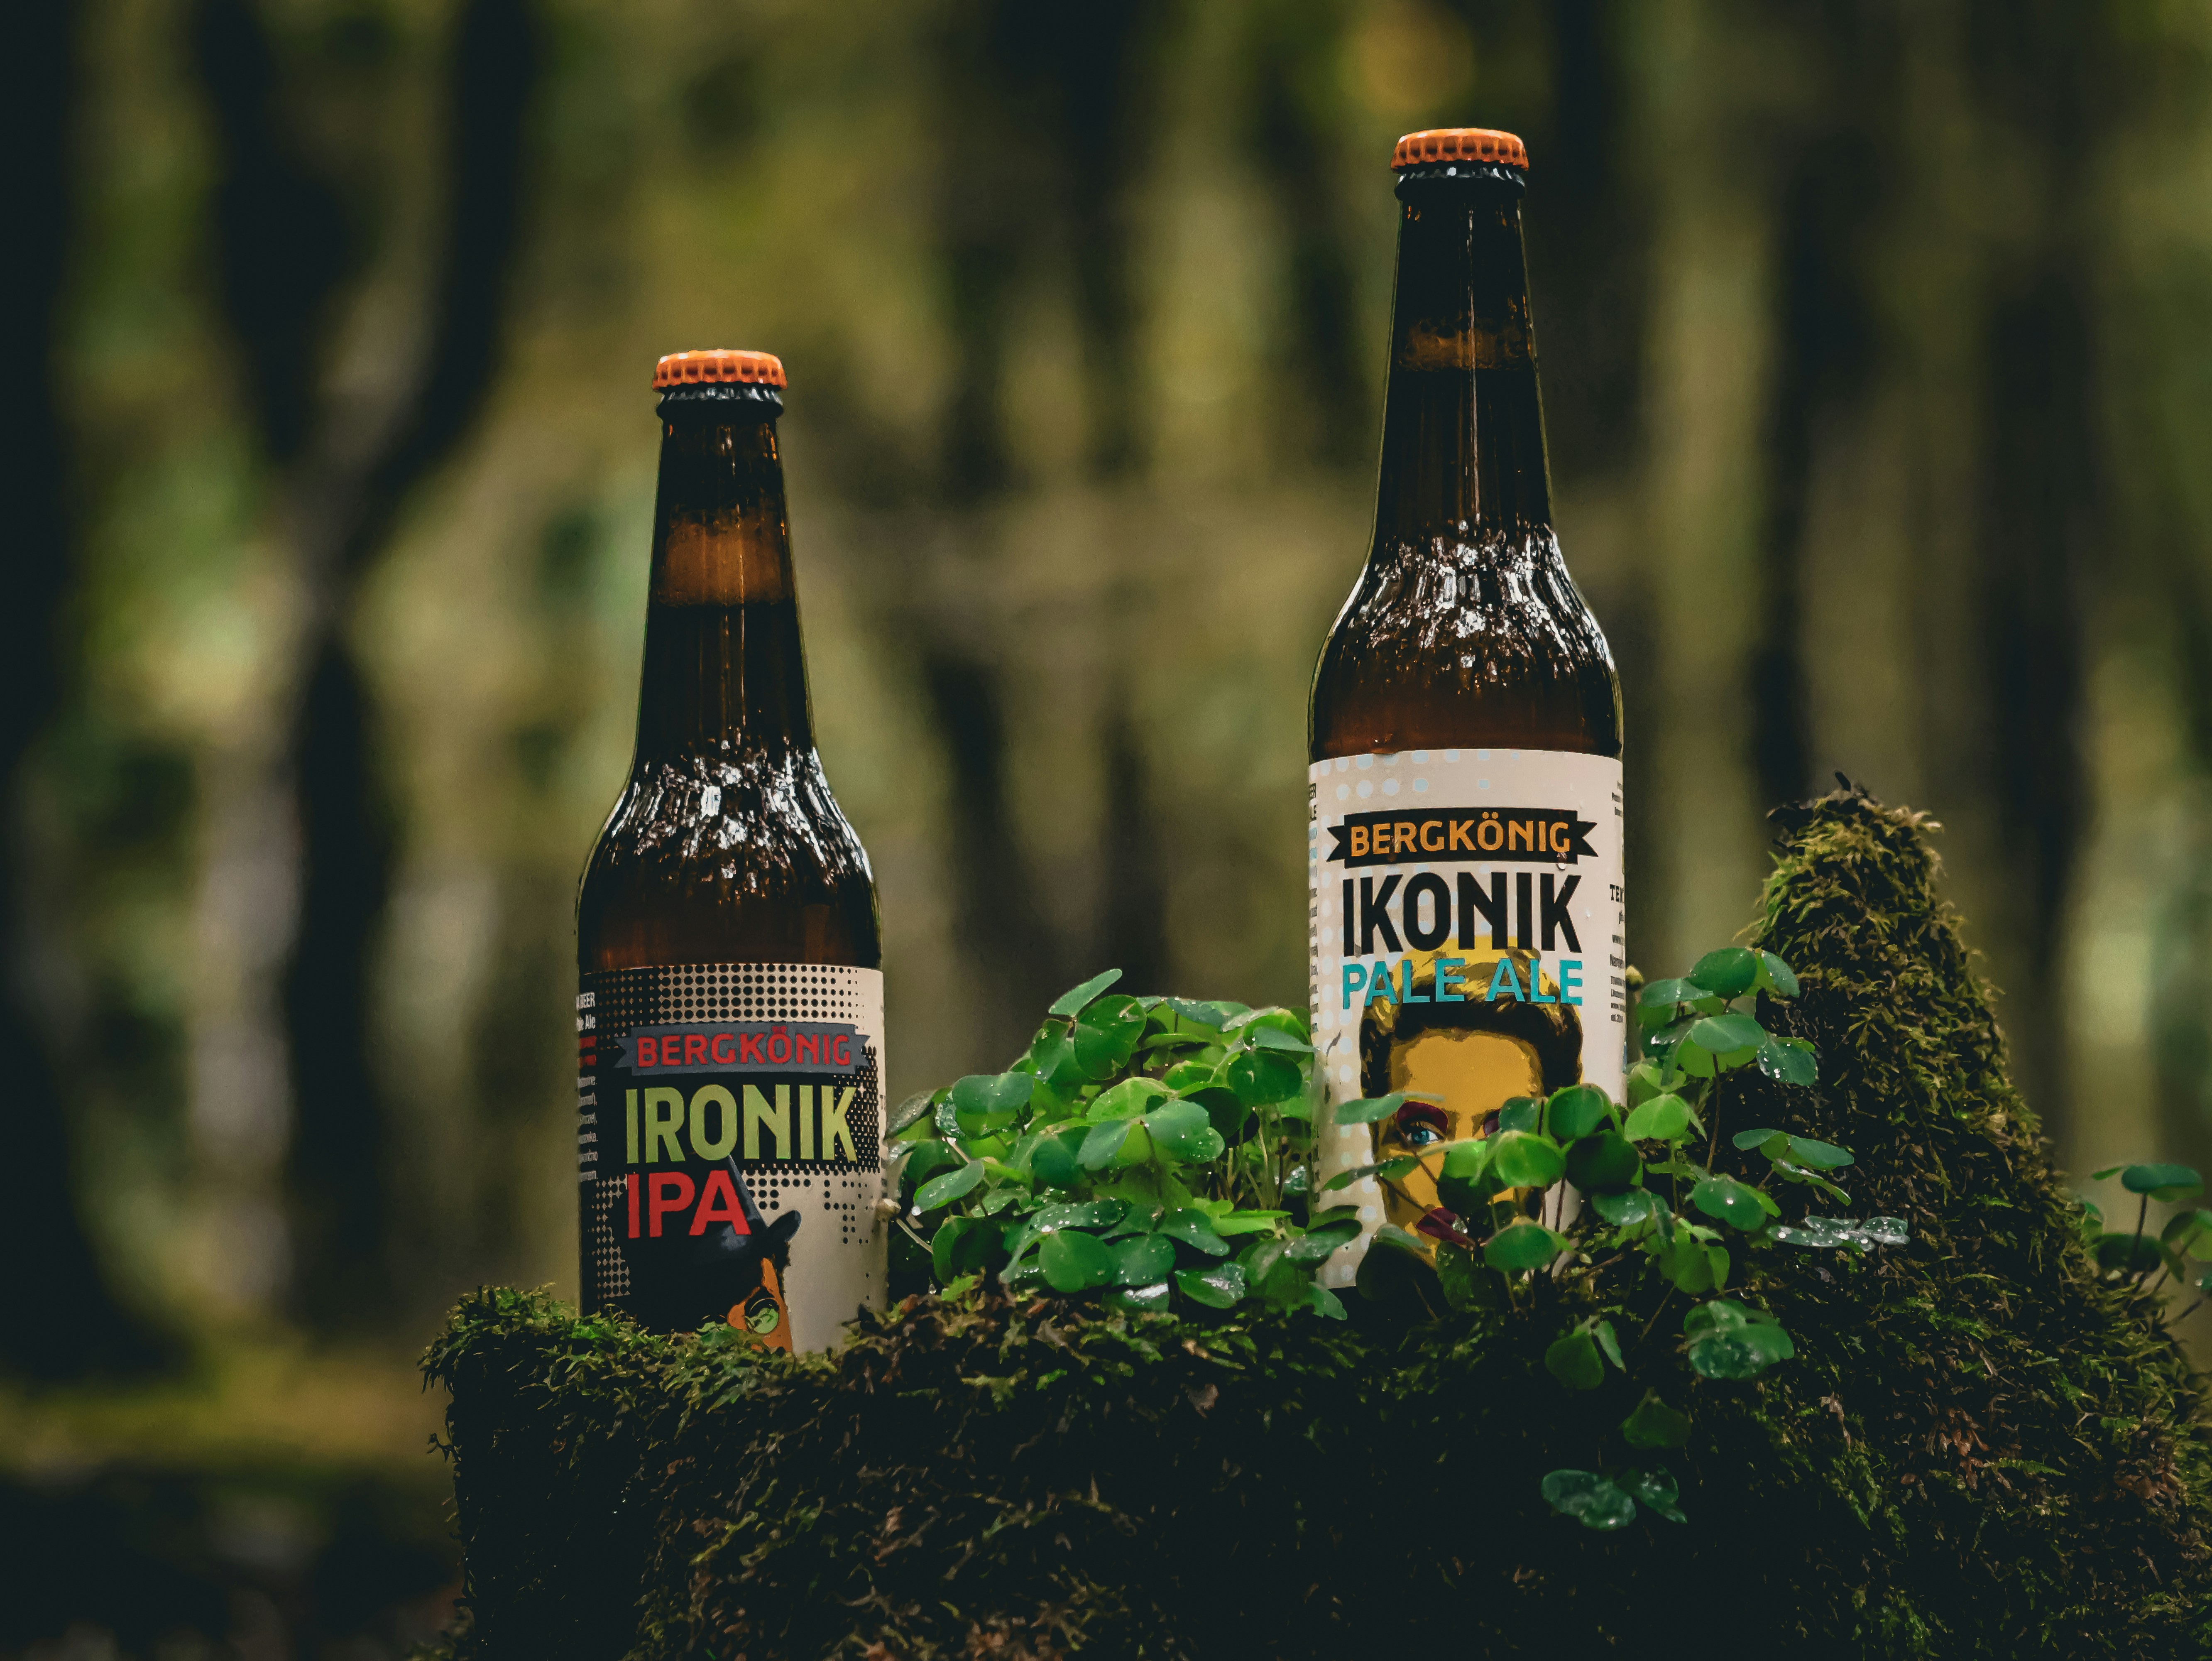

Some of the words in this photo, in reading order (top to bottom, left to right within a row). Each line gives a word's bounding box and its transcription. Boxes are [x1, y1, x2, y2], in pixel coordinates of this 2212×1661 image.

[1351, 812, 1570, 857] BERGKÖNIG
[1343, 872, 1582, 956] IKONIK
[1343, 958, 1466, 1009] PALE
[1486, 958, 1583, 1006] ALE
[636, 1026, 851, 1068] BERGKÖNIG
[626, 1084, 858, 1164] IRONIK
[627, 1170, 752, 1239] IPA
